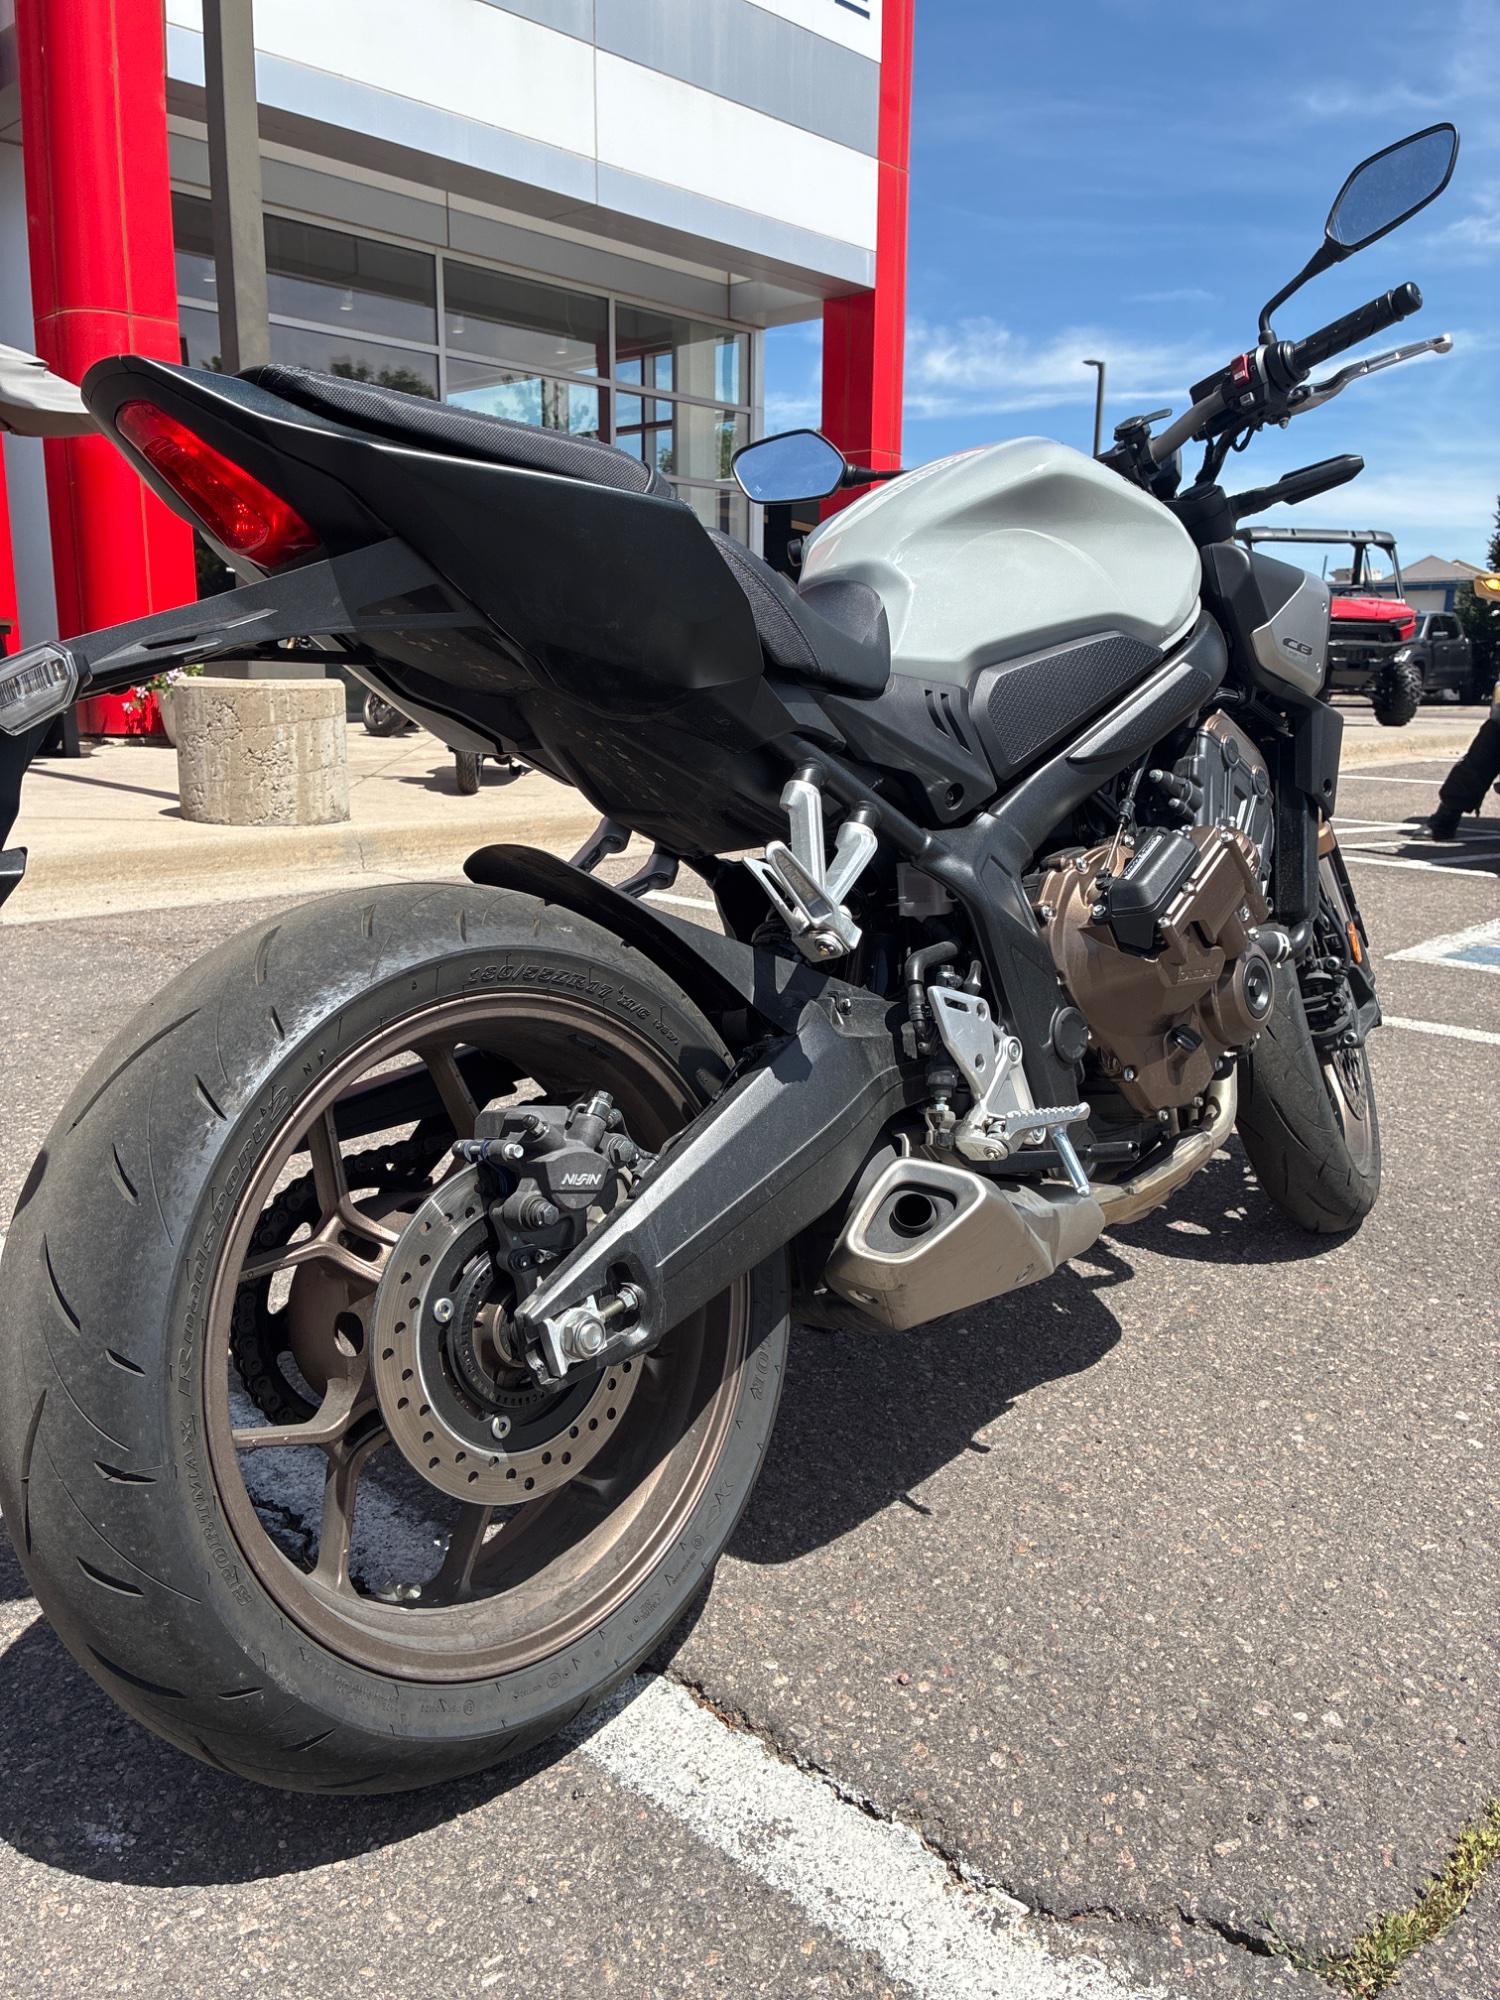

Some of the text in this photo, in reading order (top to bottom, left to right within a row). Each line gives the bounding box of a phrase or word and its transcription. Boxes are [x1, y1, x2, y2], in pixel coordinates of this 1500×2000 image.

[1282, 637, 1313, 656] CB
[561, 1172, 602, 1186] NISSIN
[178, 1416, 253, 1607] SPORTMAX
